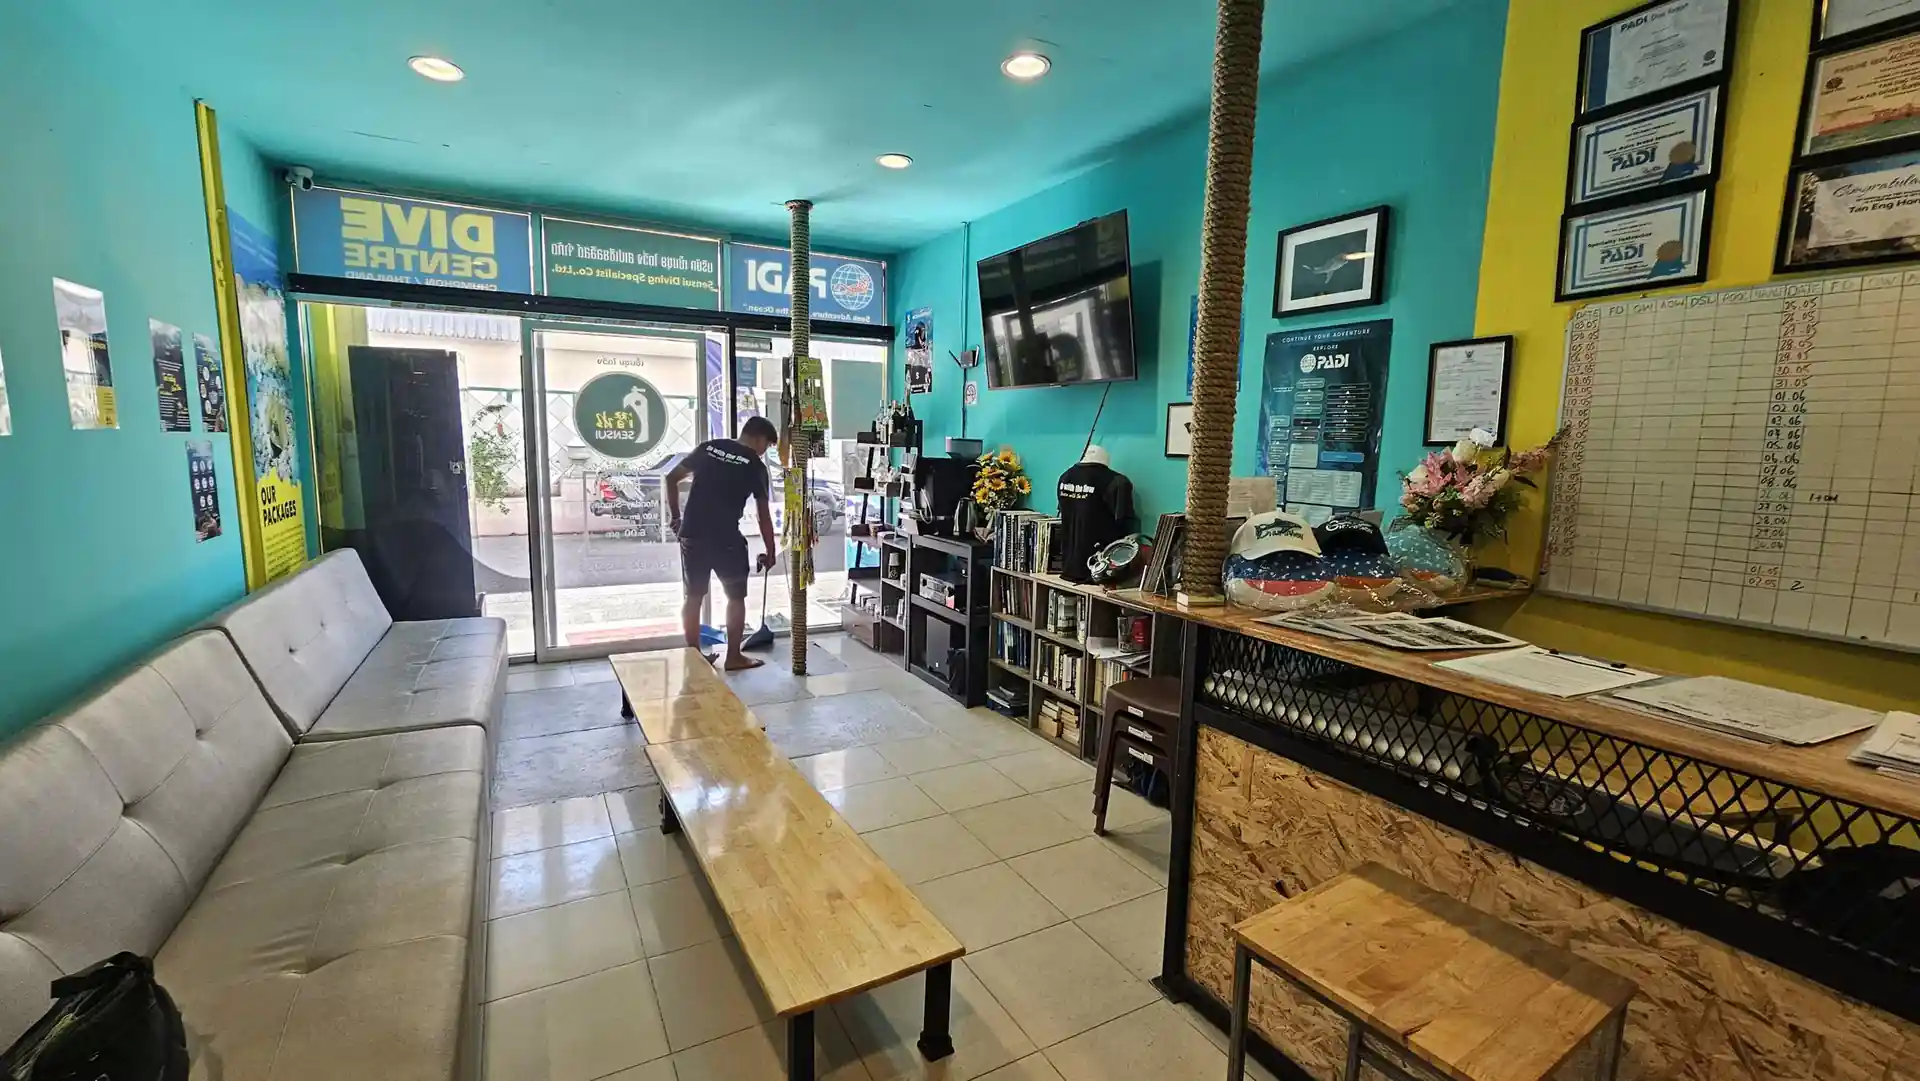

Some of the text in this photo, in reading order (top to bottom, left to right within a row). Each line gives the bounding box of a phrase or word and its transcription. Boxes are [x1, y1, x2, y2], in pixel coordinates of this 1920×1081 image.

[1611, 148, 1657, 172] PADI
[1849, 206, 1869, 214] Tan
[1871, 201, 1894, 211] Eng
[1600, 243, 1645, 265] PADI
[1609, 306, 1624, 316] FD
[1282, 335, 1311, 344] CONTINUE
[1333, 328, 1371, 337] ADVENTURE
[1317, 353, 1350, 370] PADI
[1775, 390, 1805, 400] 01.06
[1772, 403, 1806, 413] 02.06
[1764, 452, 1799, 464] 06.06
[261, 485, 277, 505] OUR
[262, 499, 297, 527] PACKAGES
[1790, 581, 1805, 592] 2
